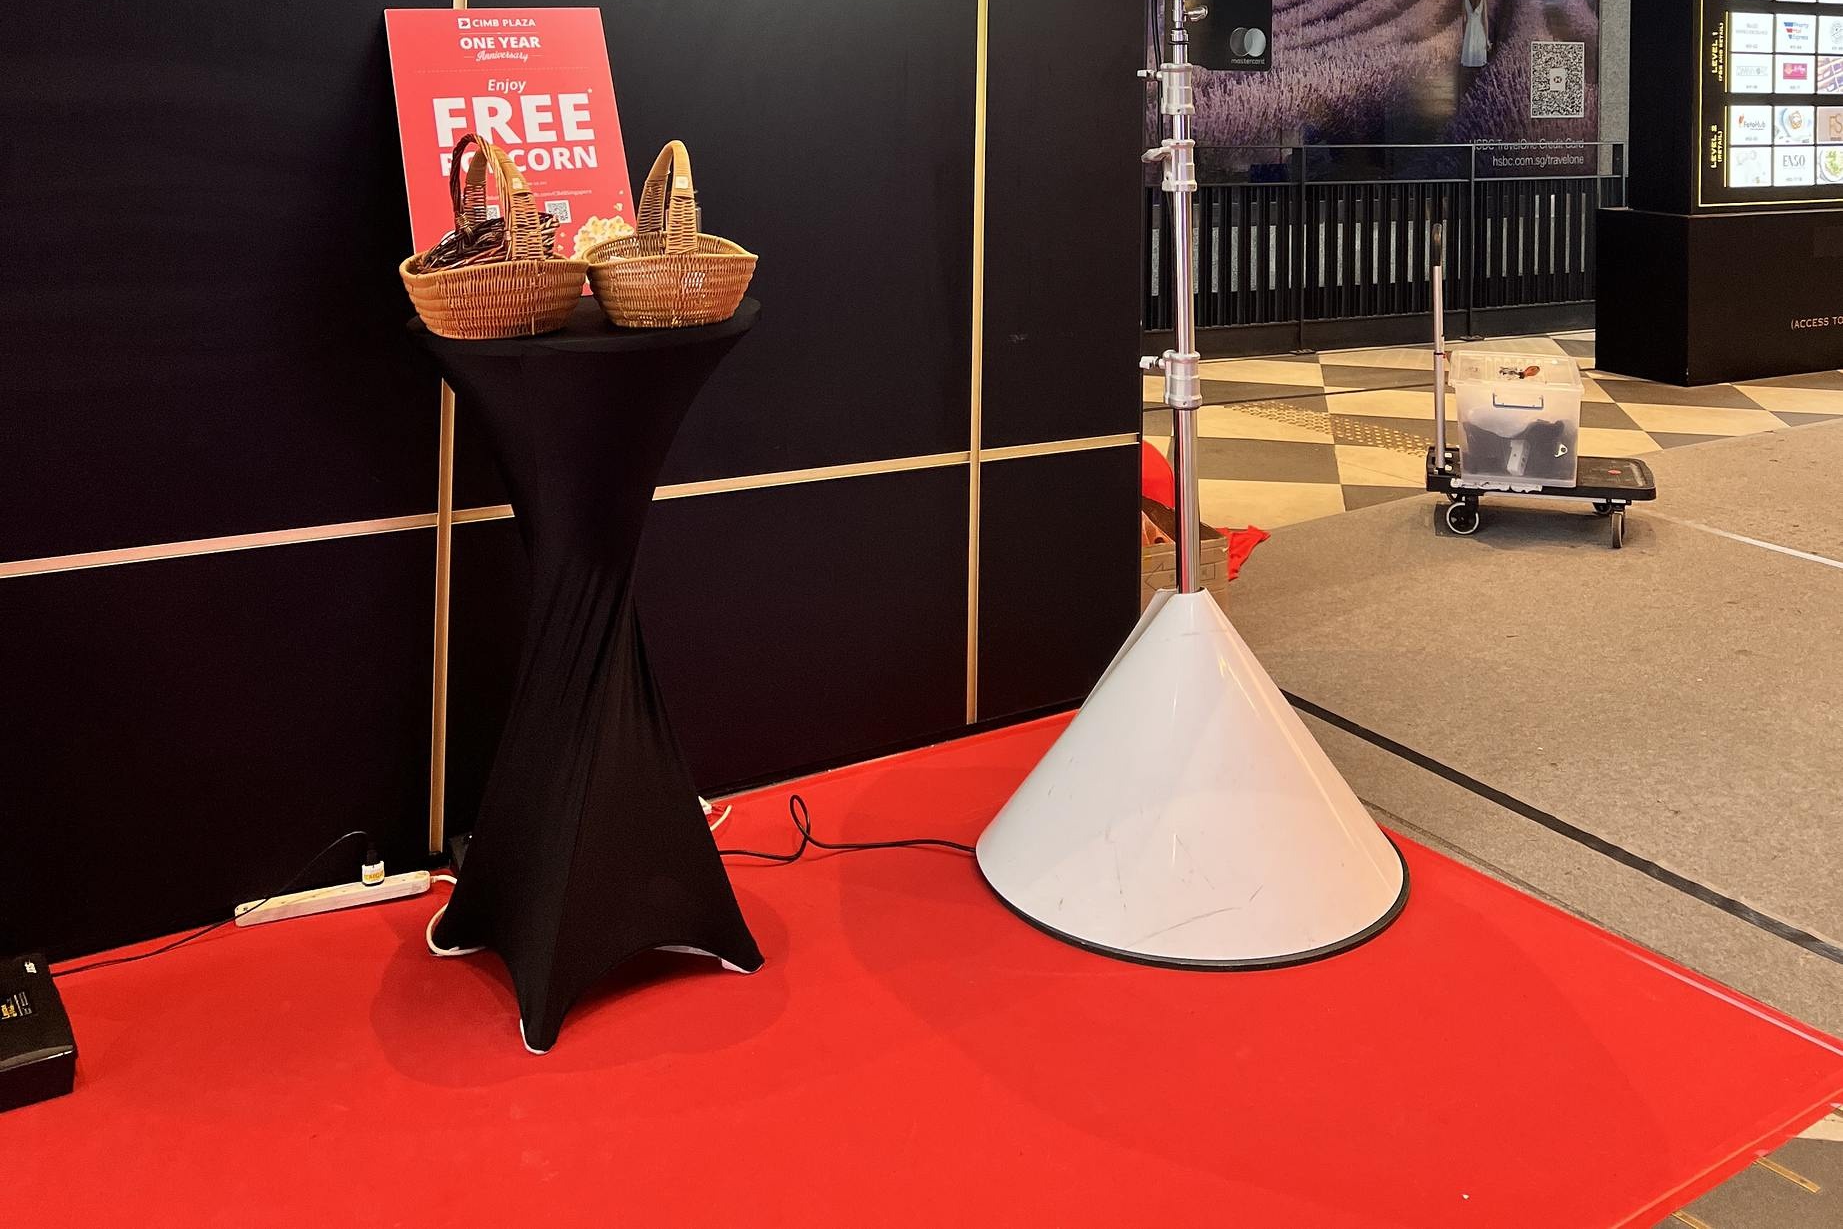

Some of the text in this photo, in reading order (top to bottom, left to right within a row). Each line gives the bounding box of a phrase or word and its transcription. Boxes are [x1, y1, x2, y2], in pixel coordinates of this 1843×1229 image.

[472, 18, 537, 27] CIMB PLAZA
[460, 36, 542, 50] ONE YEAR
[476, 50, 529, 63] Anniversary
[488, 78, 527, 94] Enjoy
[1710, 134, 1718, 169] LEVEL
[1492, 155, 1584, 167] hsbc.com.sg/travelone
[1790, 317, 1829, 331] (ACCESS
